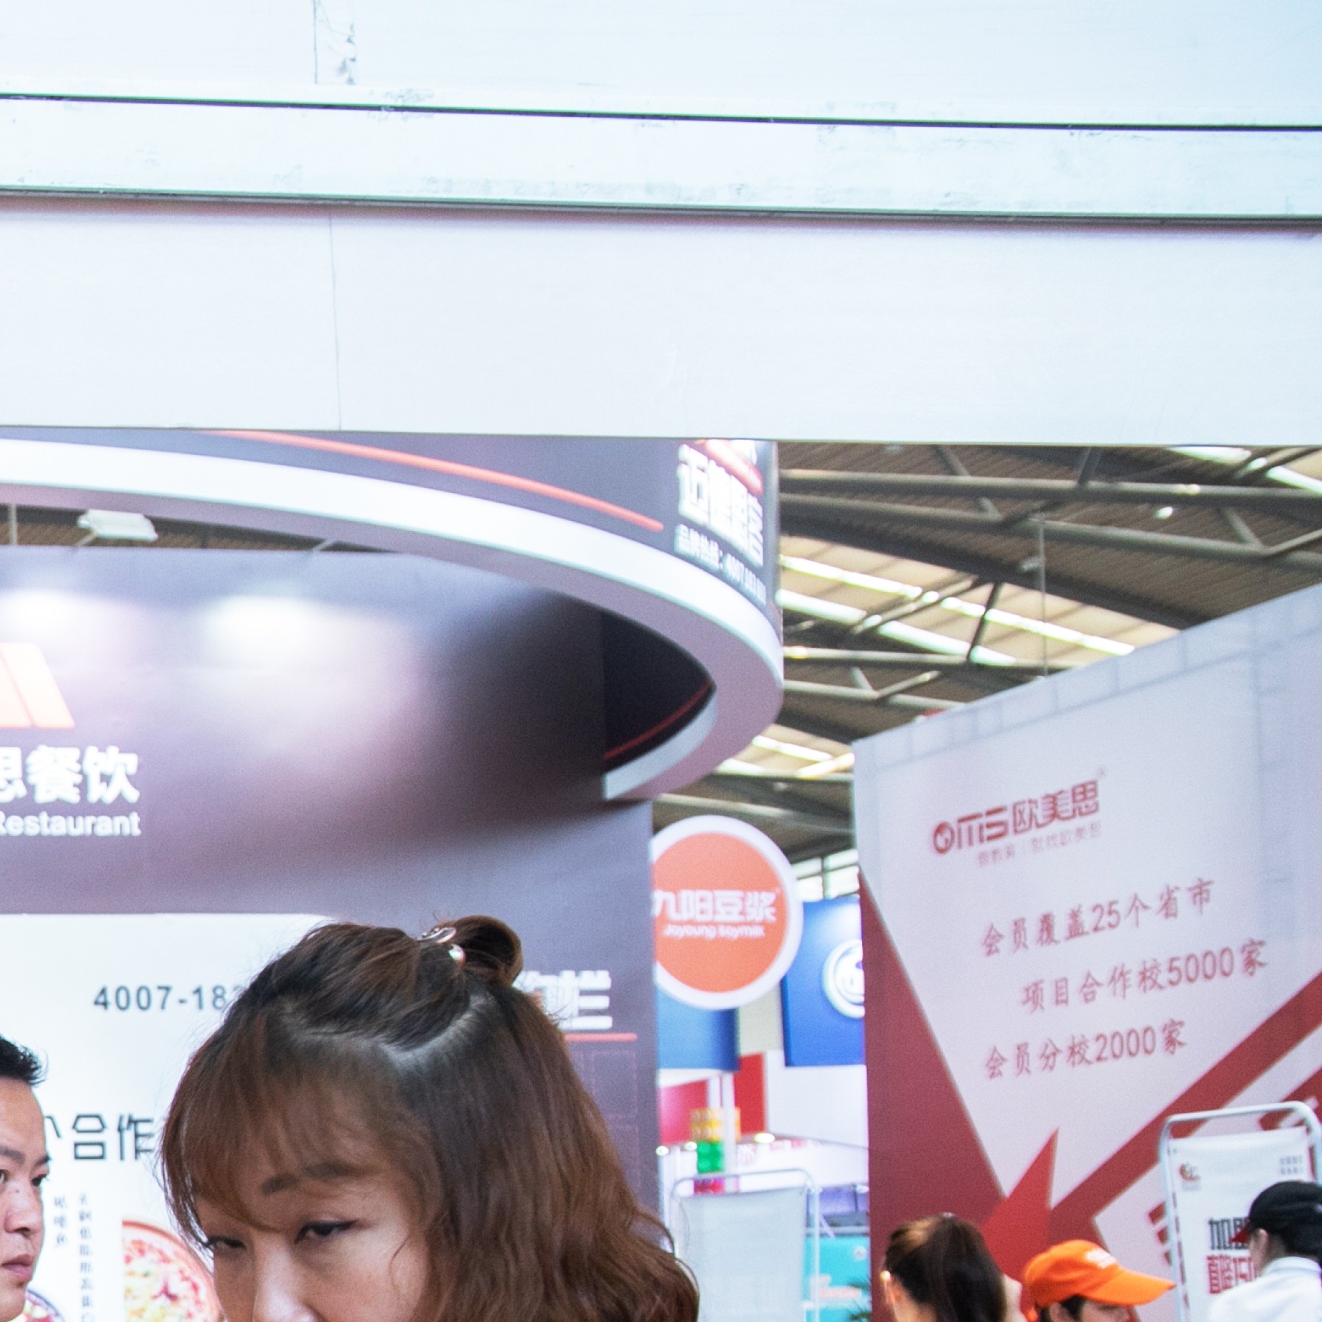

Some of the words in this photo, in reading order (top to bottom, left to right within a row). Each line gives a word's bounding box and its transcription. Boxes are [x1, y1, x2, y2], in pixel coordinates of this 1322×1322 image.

[981, 877, 1215, 958] 会员覆盖25个省市
[1021, 936, 1268, 1014] 项目合作校5000家
[984, 1018, 1187, 1081] 会员分校2000家
